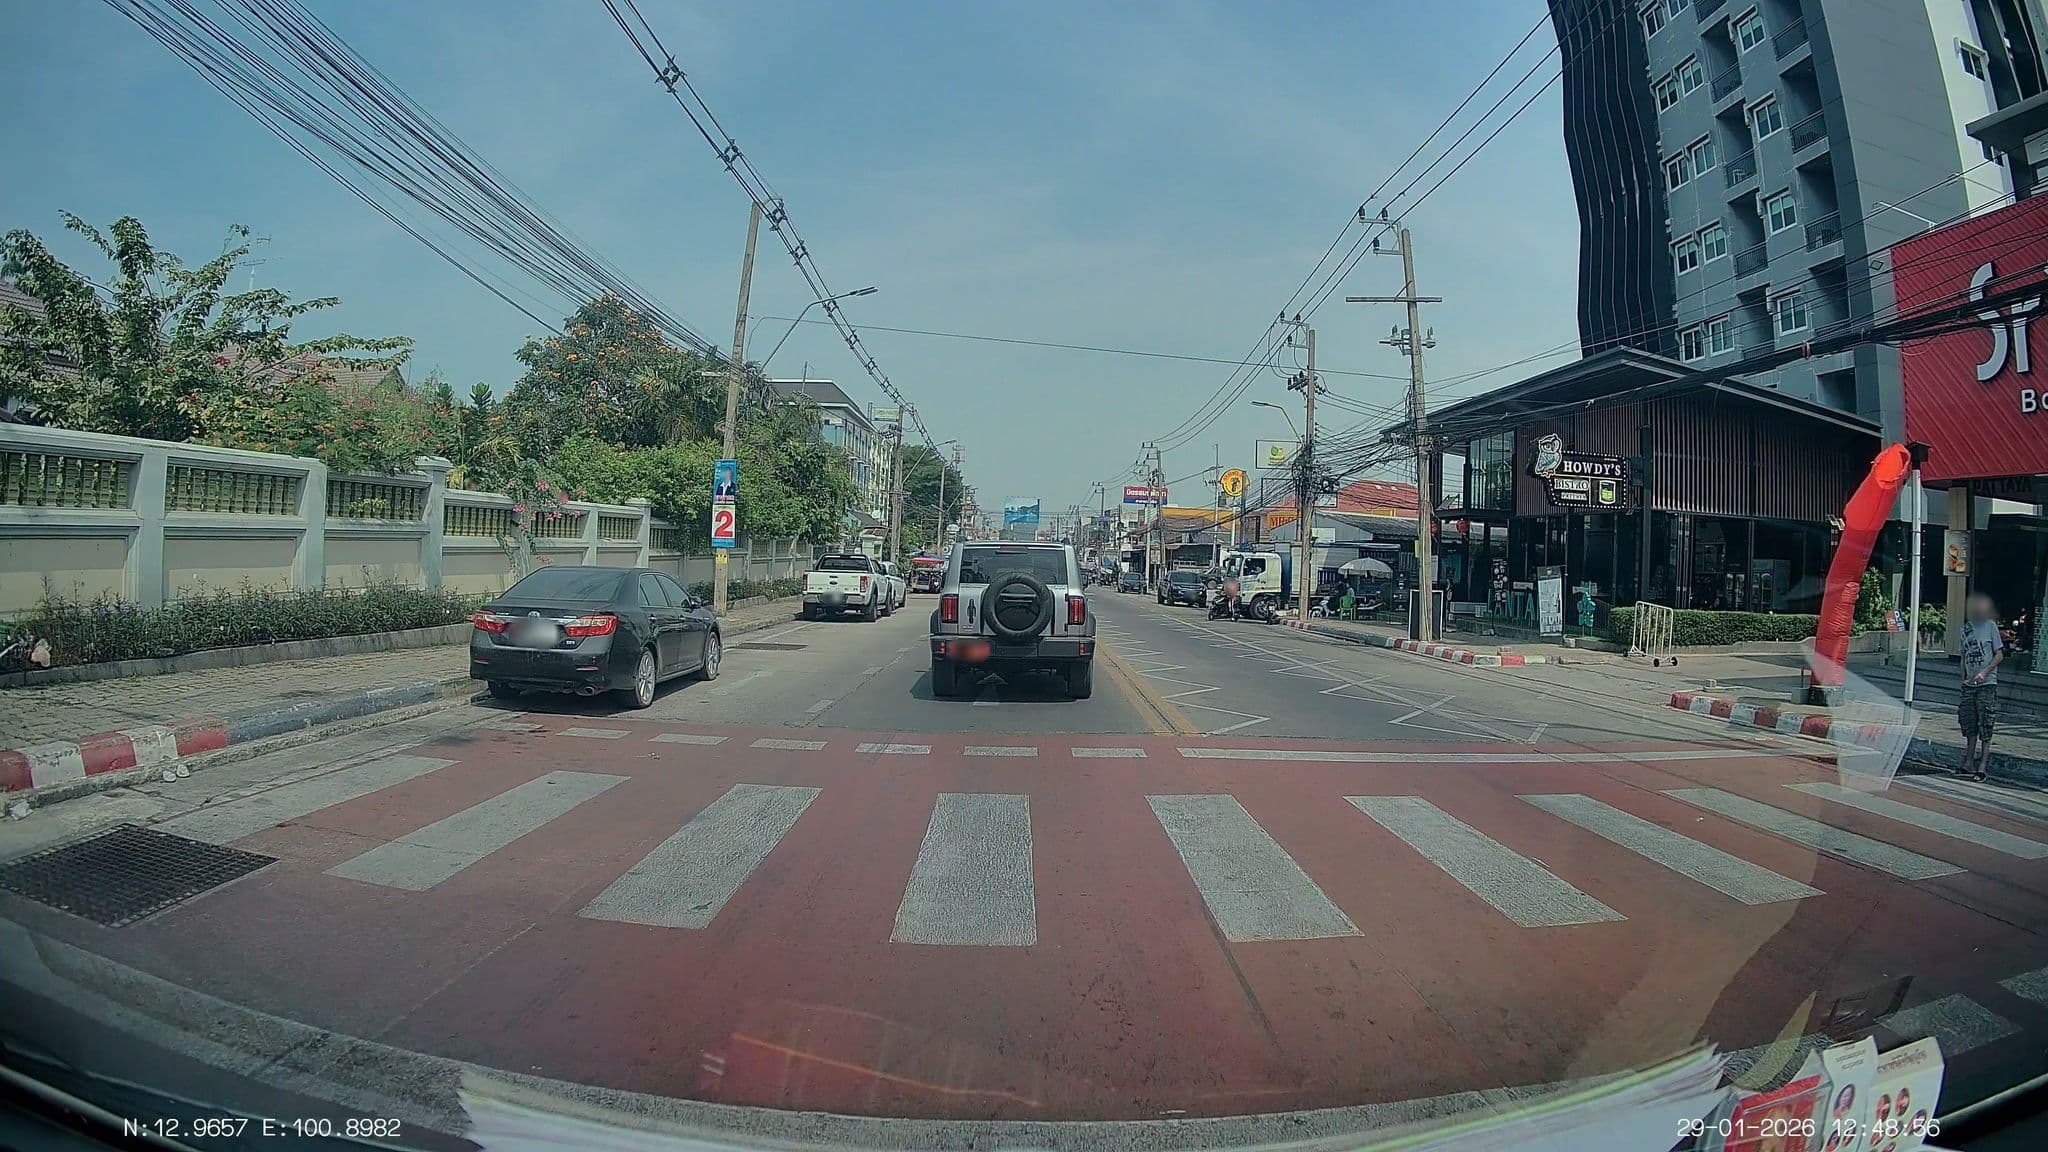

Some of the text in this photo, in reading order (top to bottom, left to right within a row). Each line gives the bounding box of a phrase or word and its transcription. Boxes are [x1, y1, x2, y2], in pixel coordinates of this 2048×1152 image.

[1970, 262, 2048, 380] Sr
[1563, 460, 1621, 476] HOWDY'S
[714, 510, 734, 537] 2
